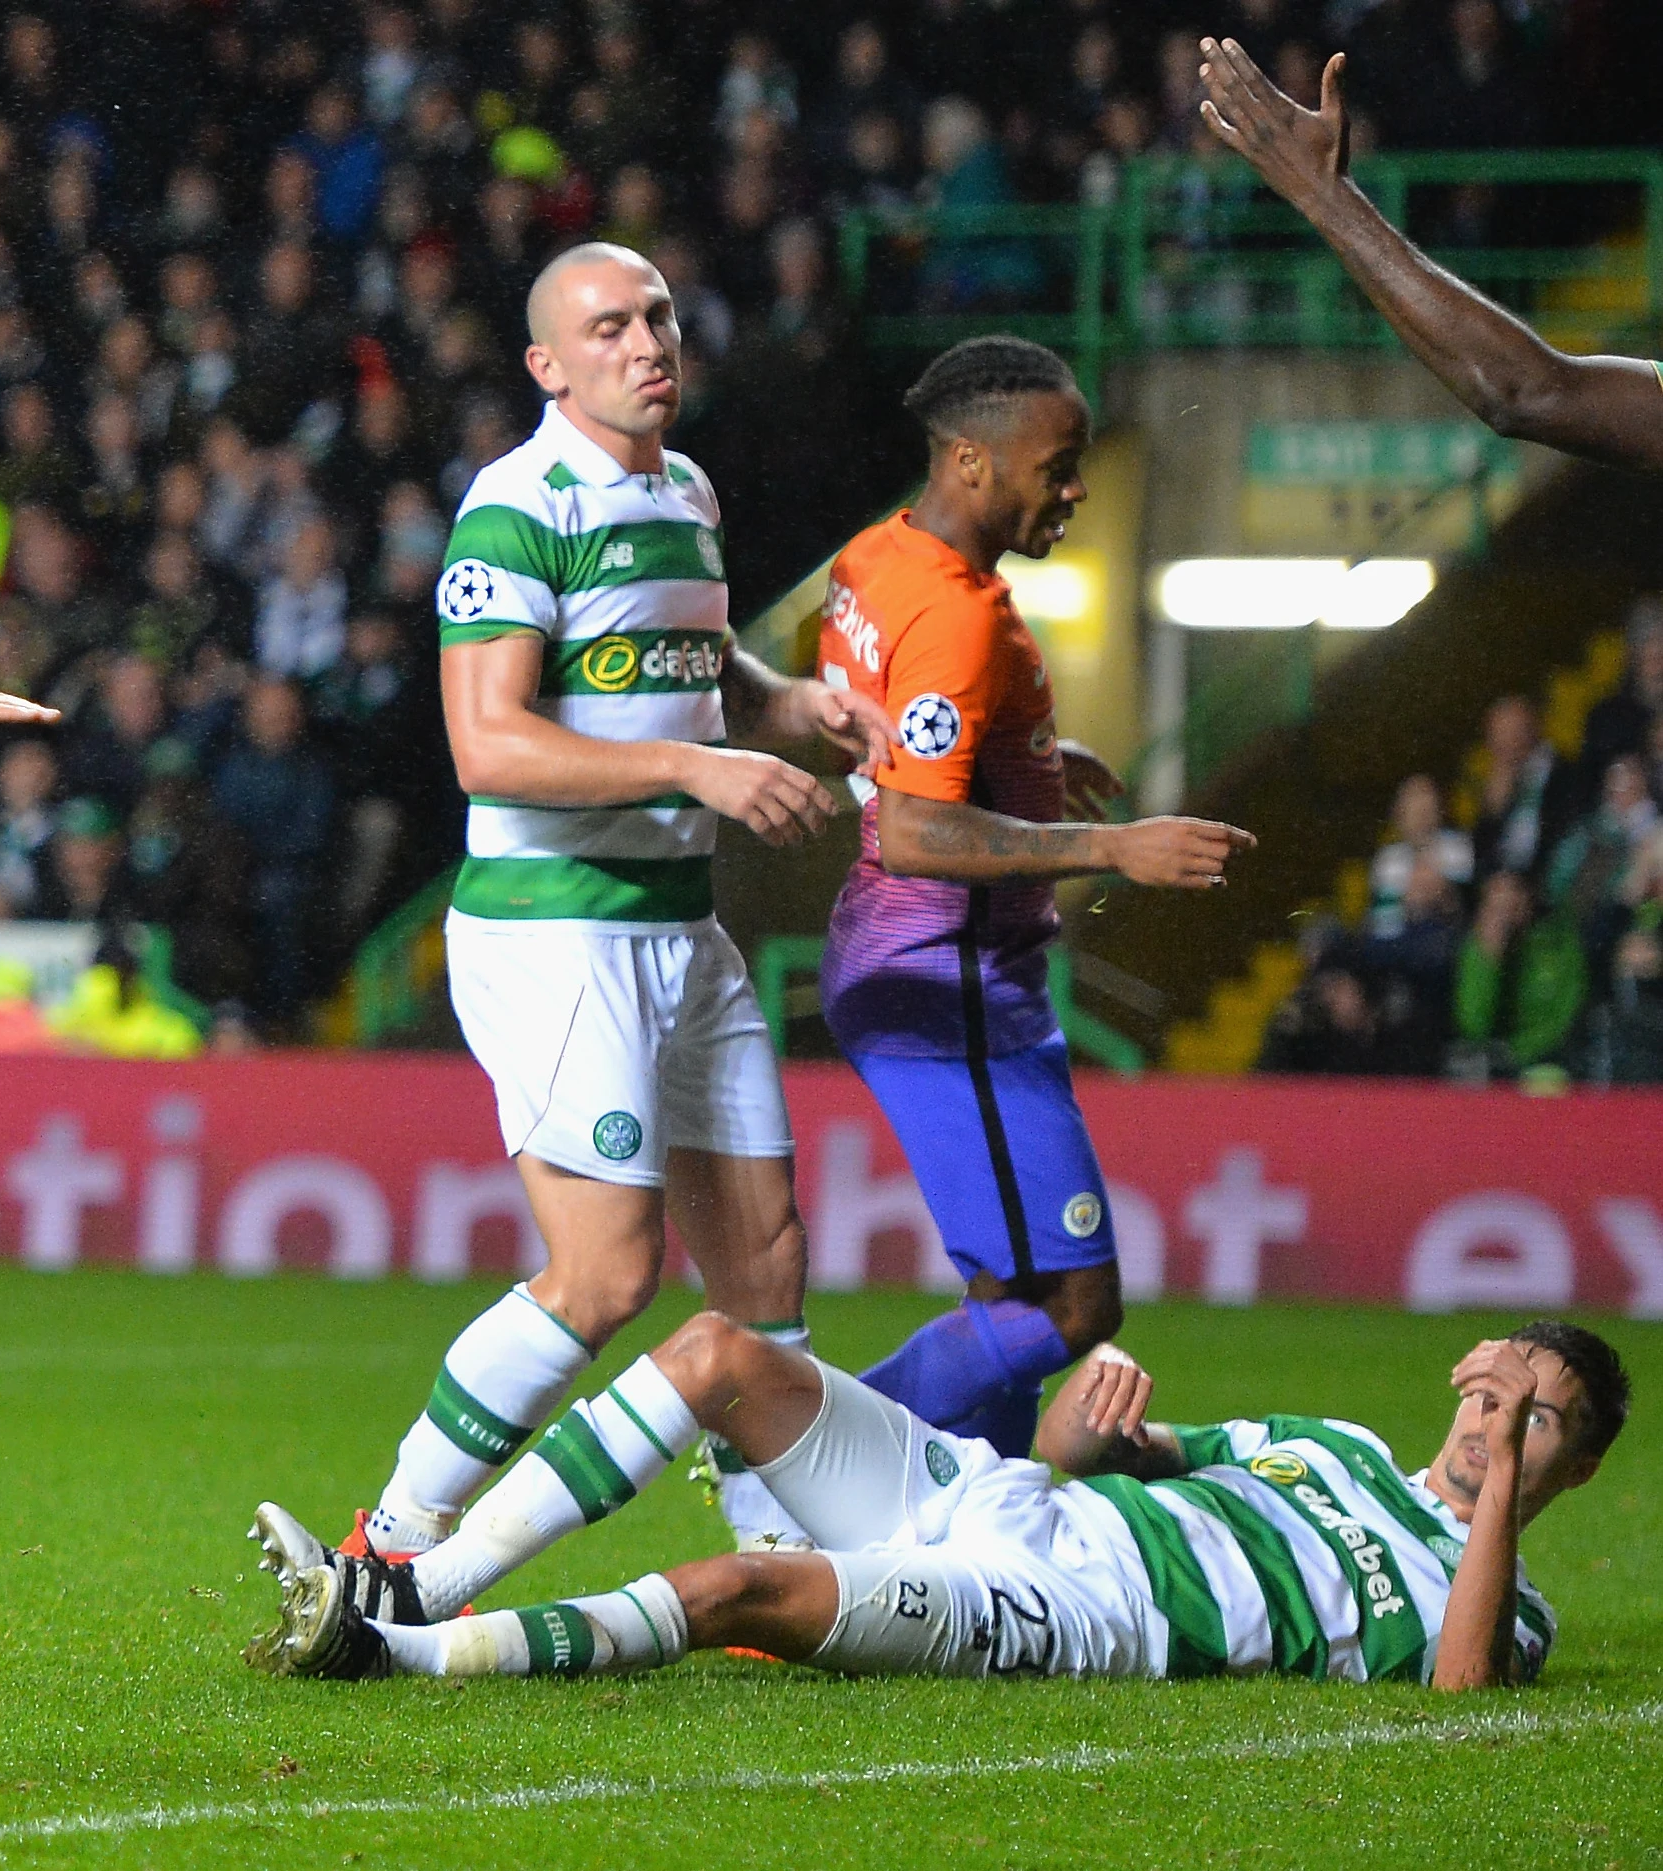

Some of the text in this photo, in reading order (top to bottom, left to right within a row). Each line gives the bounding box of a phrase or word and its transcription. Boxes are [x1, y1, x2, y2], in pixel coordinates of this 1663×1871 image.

[1293, 1483, 1405, 1620] dafabet
[898, 1580, 929, 1620] 23
[542, 1611, 571, 1670] CELTIC
